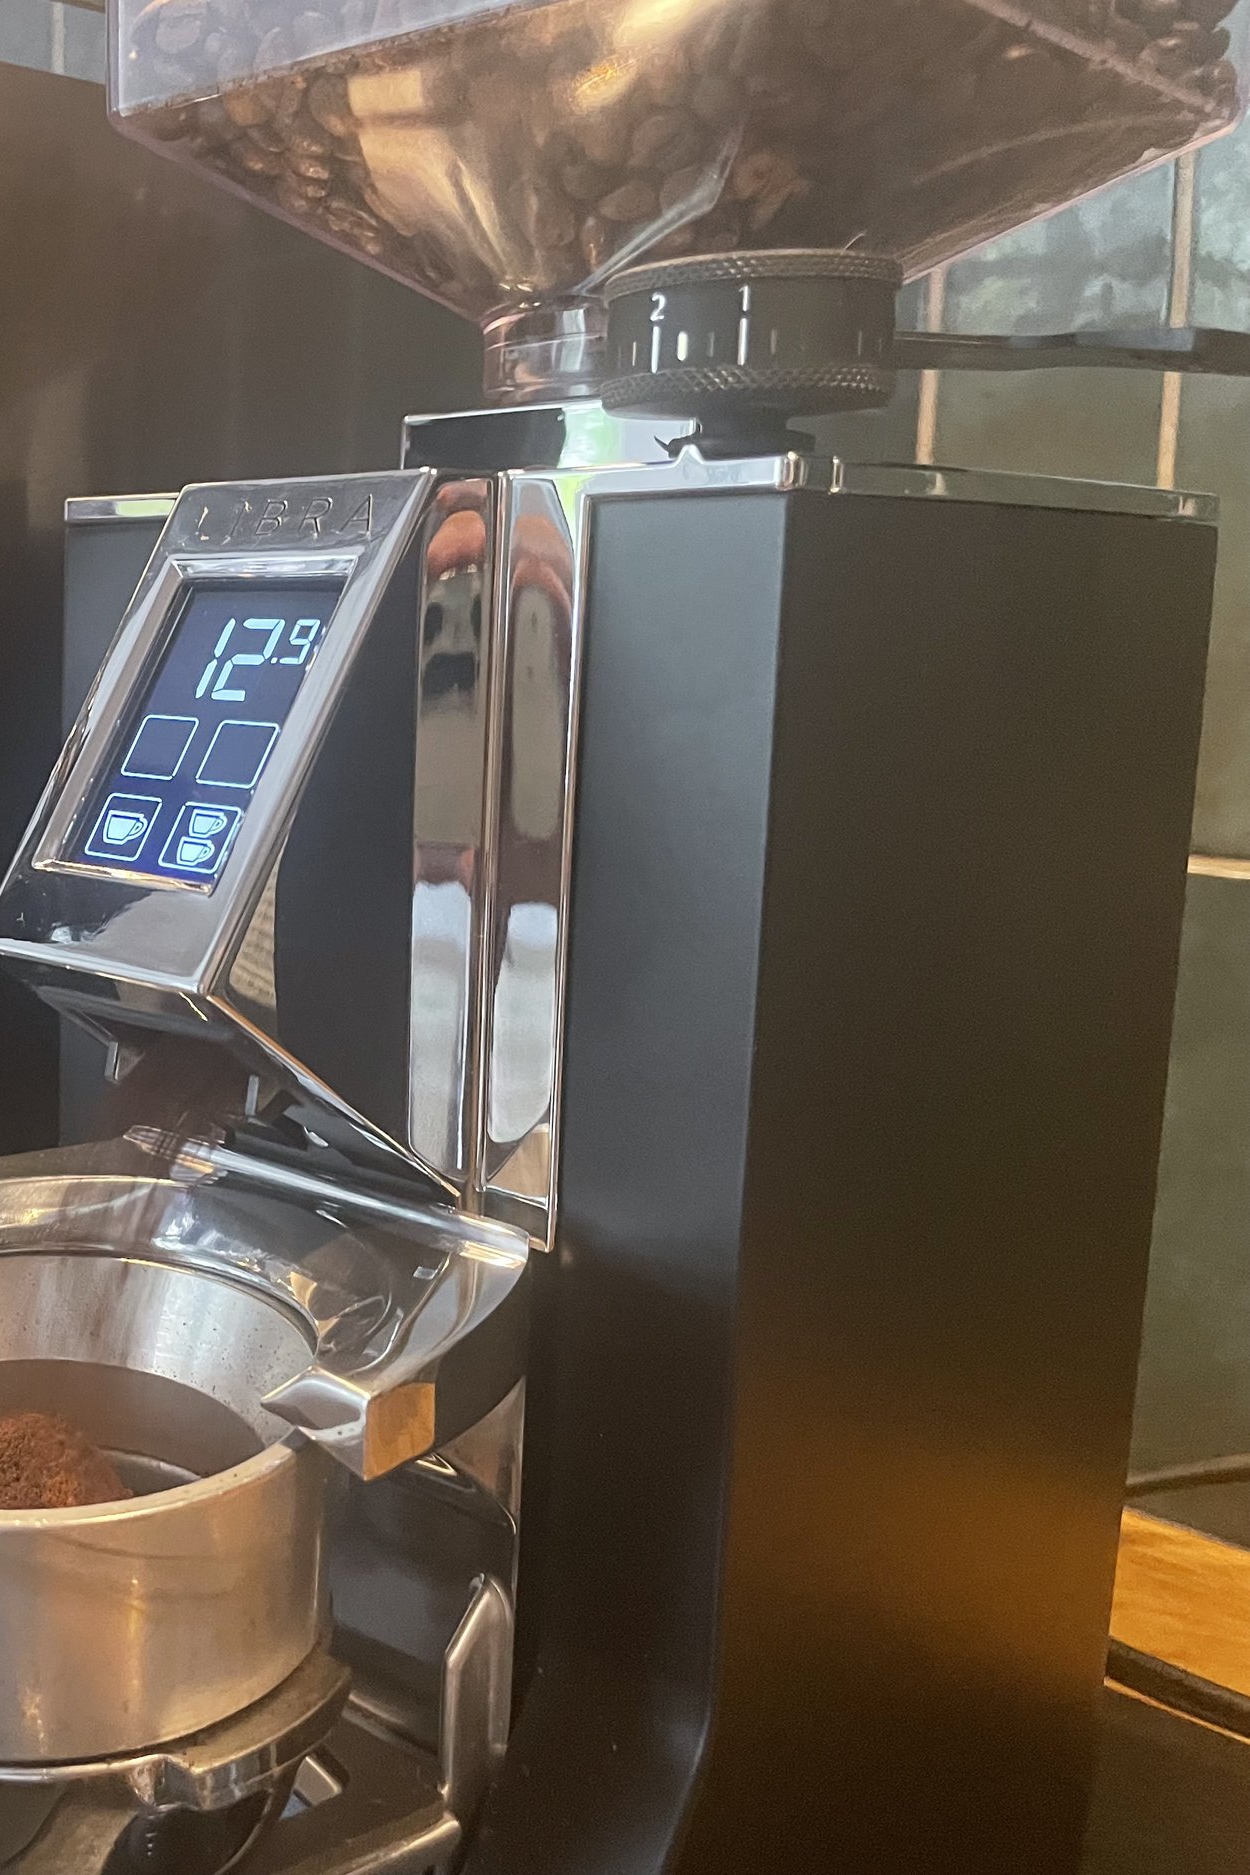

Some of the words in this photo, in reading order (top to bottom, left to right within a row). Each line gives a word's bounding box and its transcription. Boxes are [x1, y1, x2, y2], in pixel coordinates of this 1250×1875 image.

[650, 292, 667, 322] 2
[738, 284, 750, 313] 1
[181, 493, 374, 546] LIBRA
[194, 617, 321, 702] 12.9
